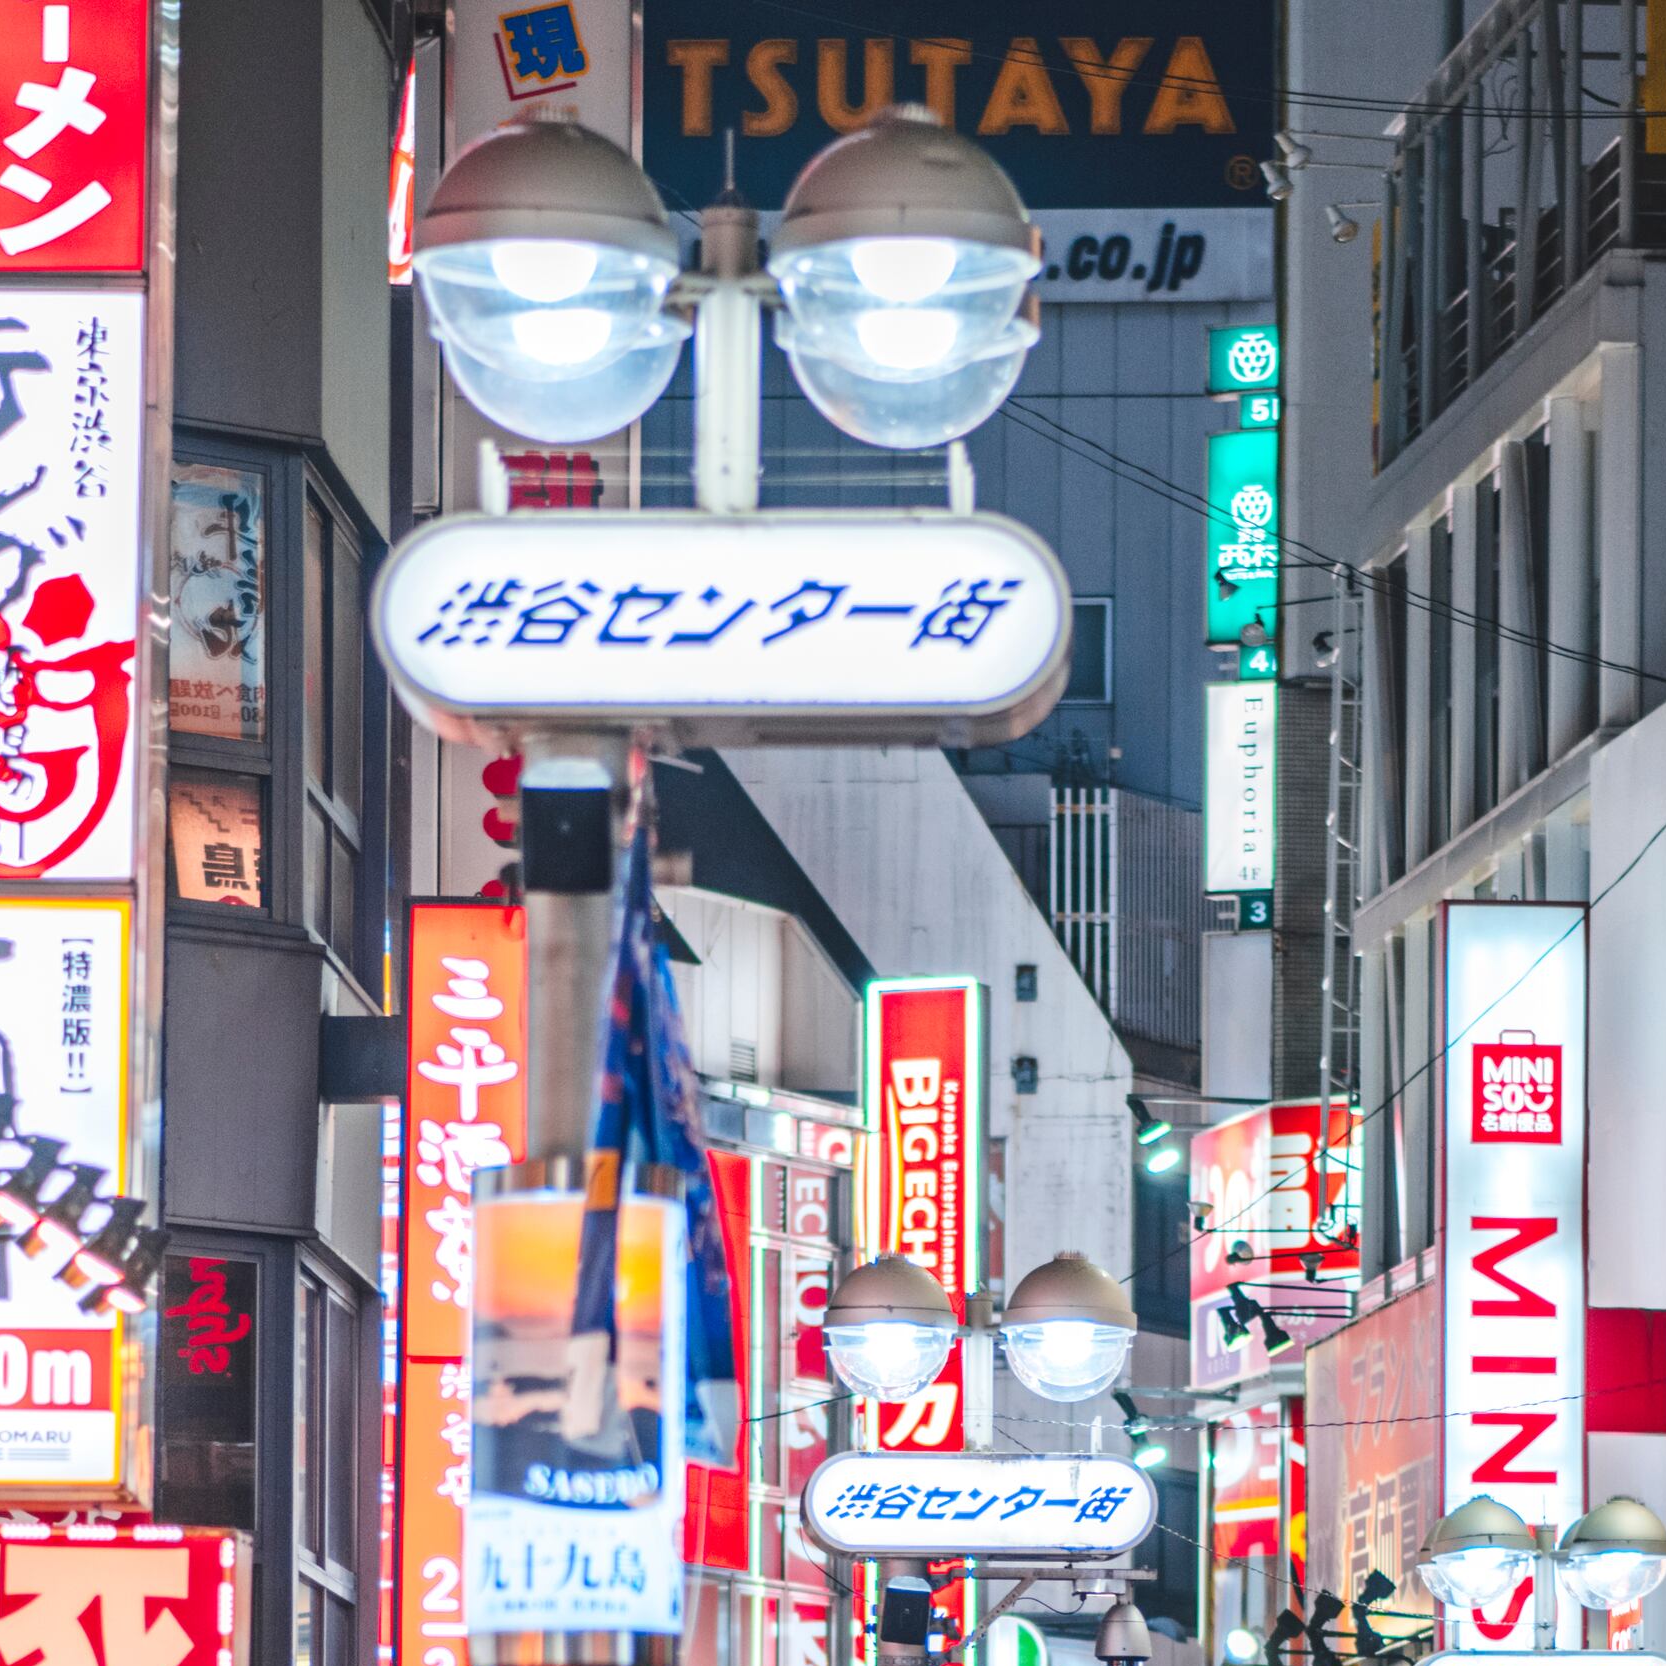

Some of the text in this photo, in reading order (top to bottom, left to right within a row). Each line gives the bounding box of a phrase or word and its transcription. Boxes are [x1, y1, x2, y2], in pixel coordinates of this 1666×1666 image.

[667, 36, 1238, 137] TSUTAYA
[416, 577, 1025, 649] 渋谷センター街
[1237, 695, 1264, 855] Euphoria
[1249, 902, 1267, 923] 3
[1481, 1056, 1555, 1084] MINI
[1479, 1113, 1555, 1133] 名創優品
[890, 1058, 942, 1272] BIG ECH
[942, 1081, 961, 1294] Karaoke Entertainment
[825, 1483, 1134, 1525] 渋谷センター街
[478, 1541, 648, 1594] 九十九島
